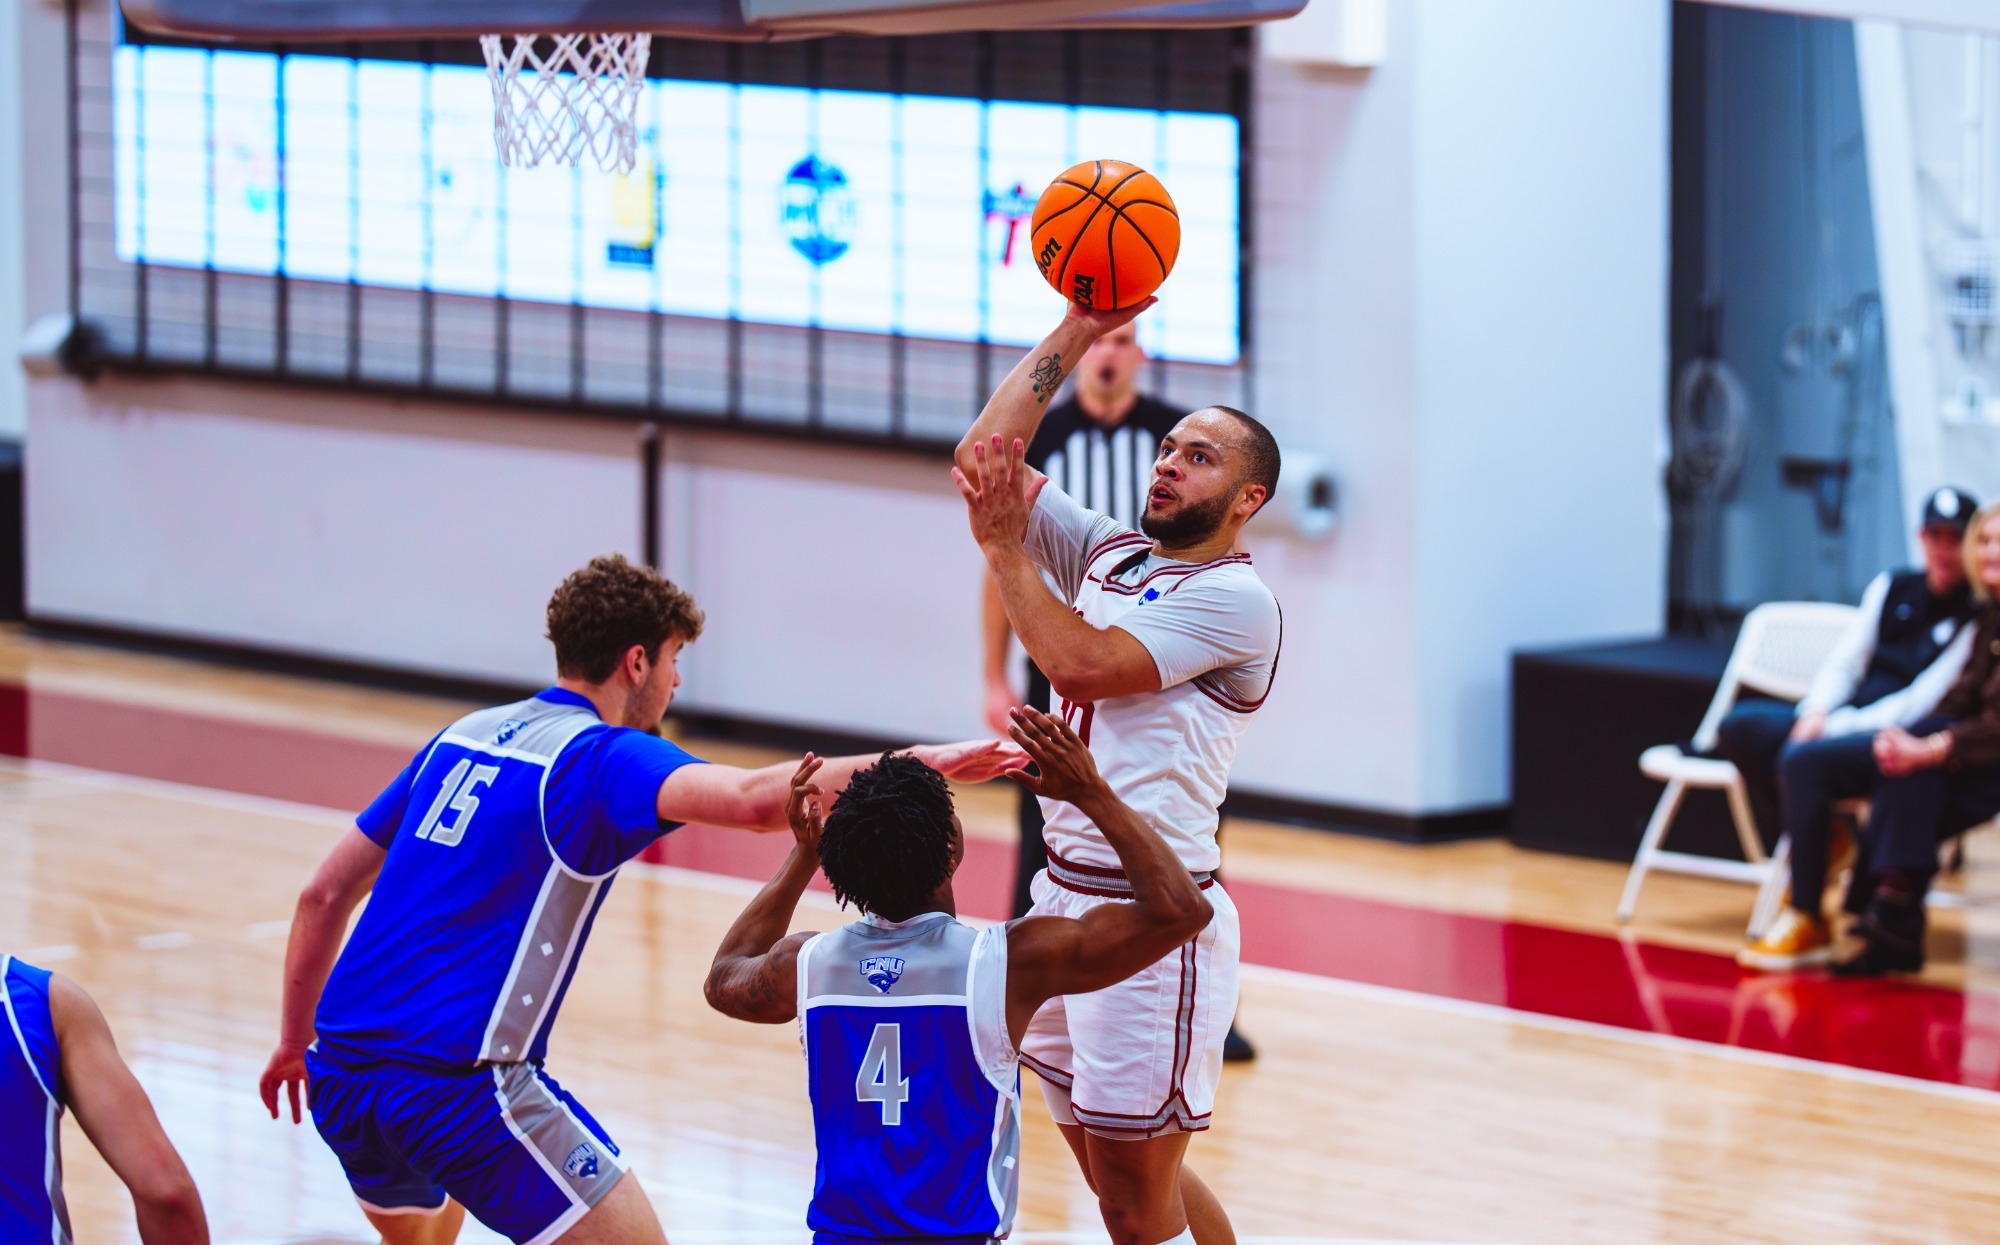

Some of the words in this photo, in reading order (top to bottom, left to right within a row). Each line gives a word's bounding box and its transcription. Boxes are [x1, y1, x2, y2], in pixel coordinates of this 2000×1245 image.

[1073, 273, 1095, 311] CAA
[415, 758, 500, 847] 15
[860, 956, 905, 975] CNU
[855, 1023, 909, 1126] 4
[562, 1141, 597, 1178] CNU
